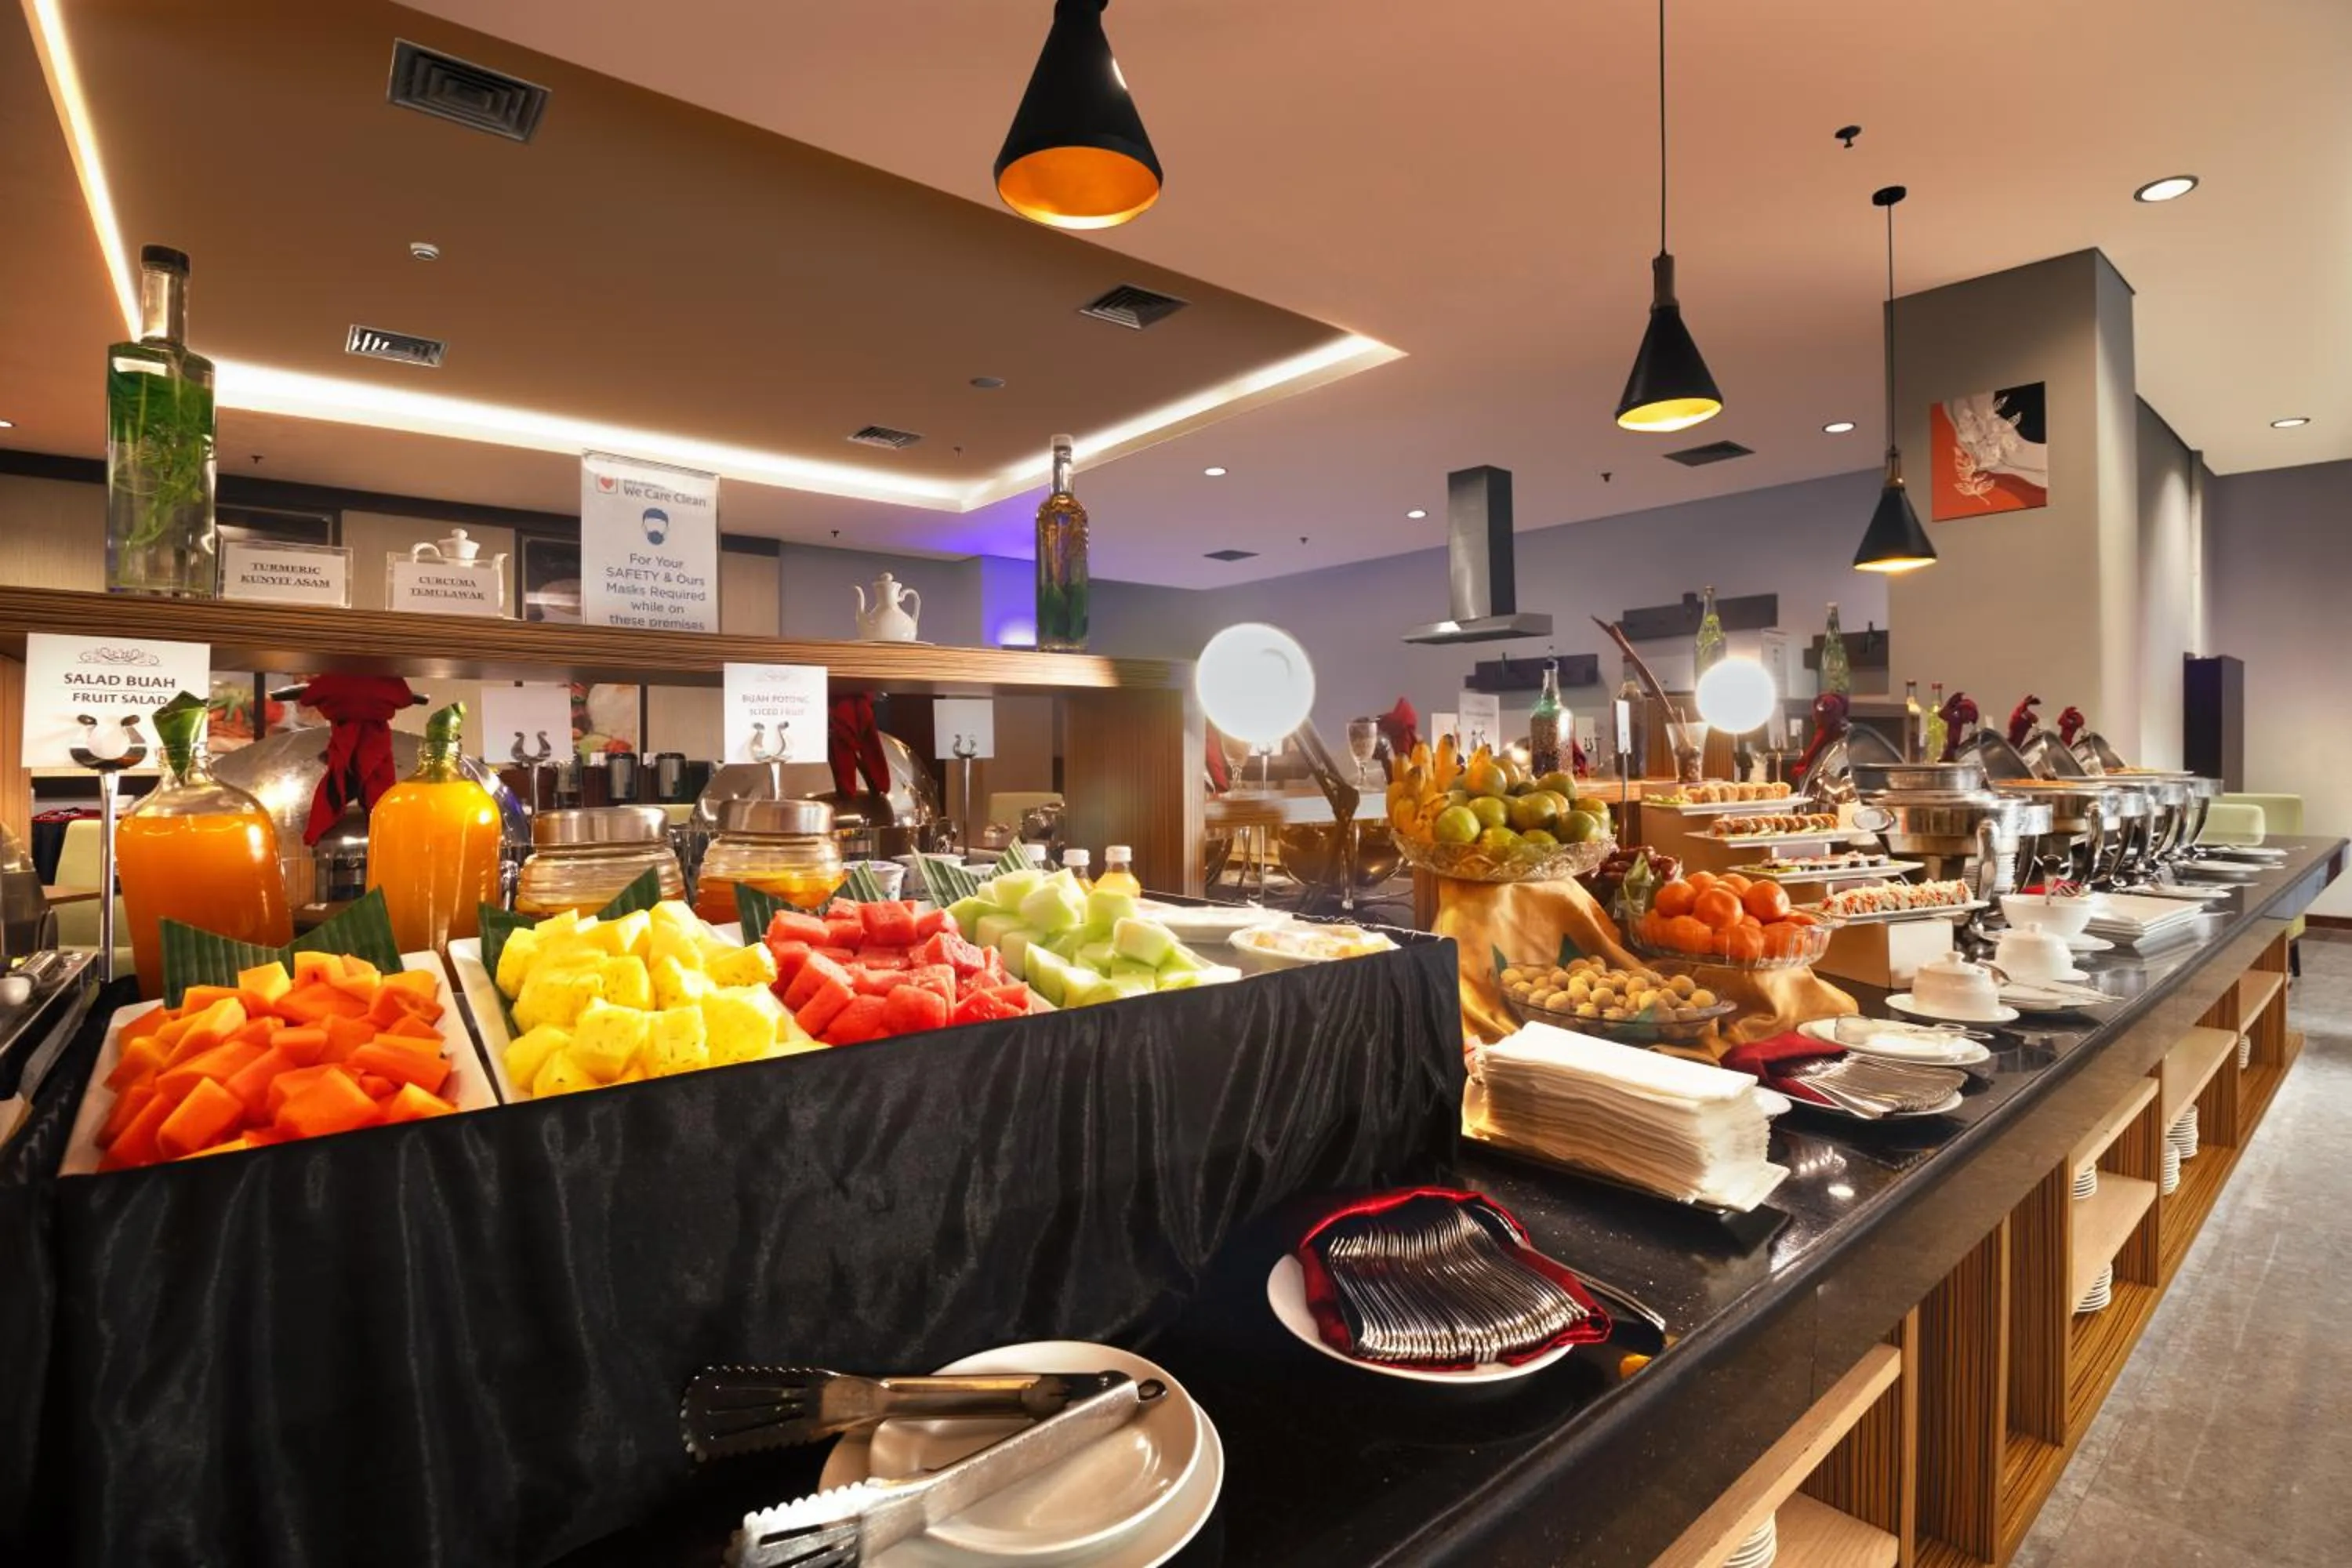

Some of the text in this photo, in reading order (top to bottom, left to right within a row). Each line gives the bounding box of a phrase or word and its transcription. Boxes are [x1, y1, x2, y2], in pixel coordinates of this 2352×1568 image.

[622, 485, 642, 497] We
[644, 488, 671, 503] Care
[673, 492, 706, 507] Clean
[250, 562, 321, 574] TURMERIC
[630, 553, 684, 568] For Your
[240, 575, 330, 588] KUNYIT ASAM
[419, 576, 477, 587] CURCUMA
[606, 567, 705, 586] SAFETY & Ours
[606, 583, 706, 601] Masks Required
[631, 601, 684, 614] while on
[609, 614, 705, 630] these premises
[64, 673, 176, 688] SALAD BUAH
[72, 692, 168, 705] FRUIT SALAD
